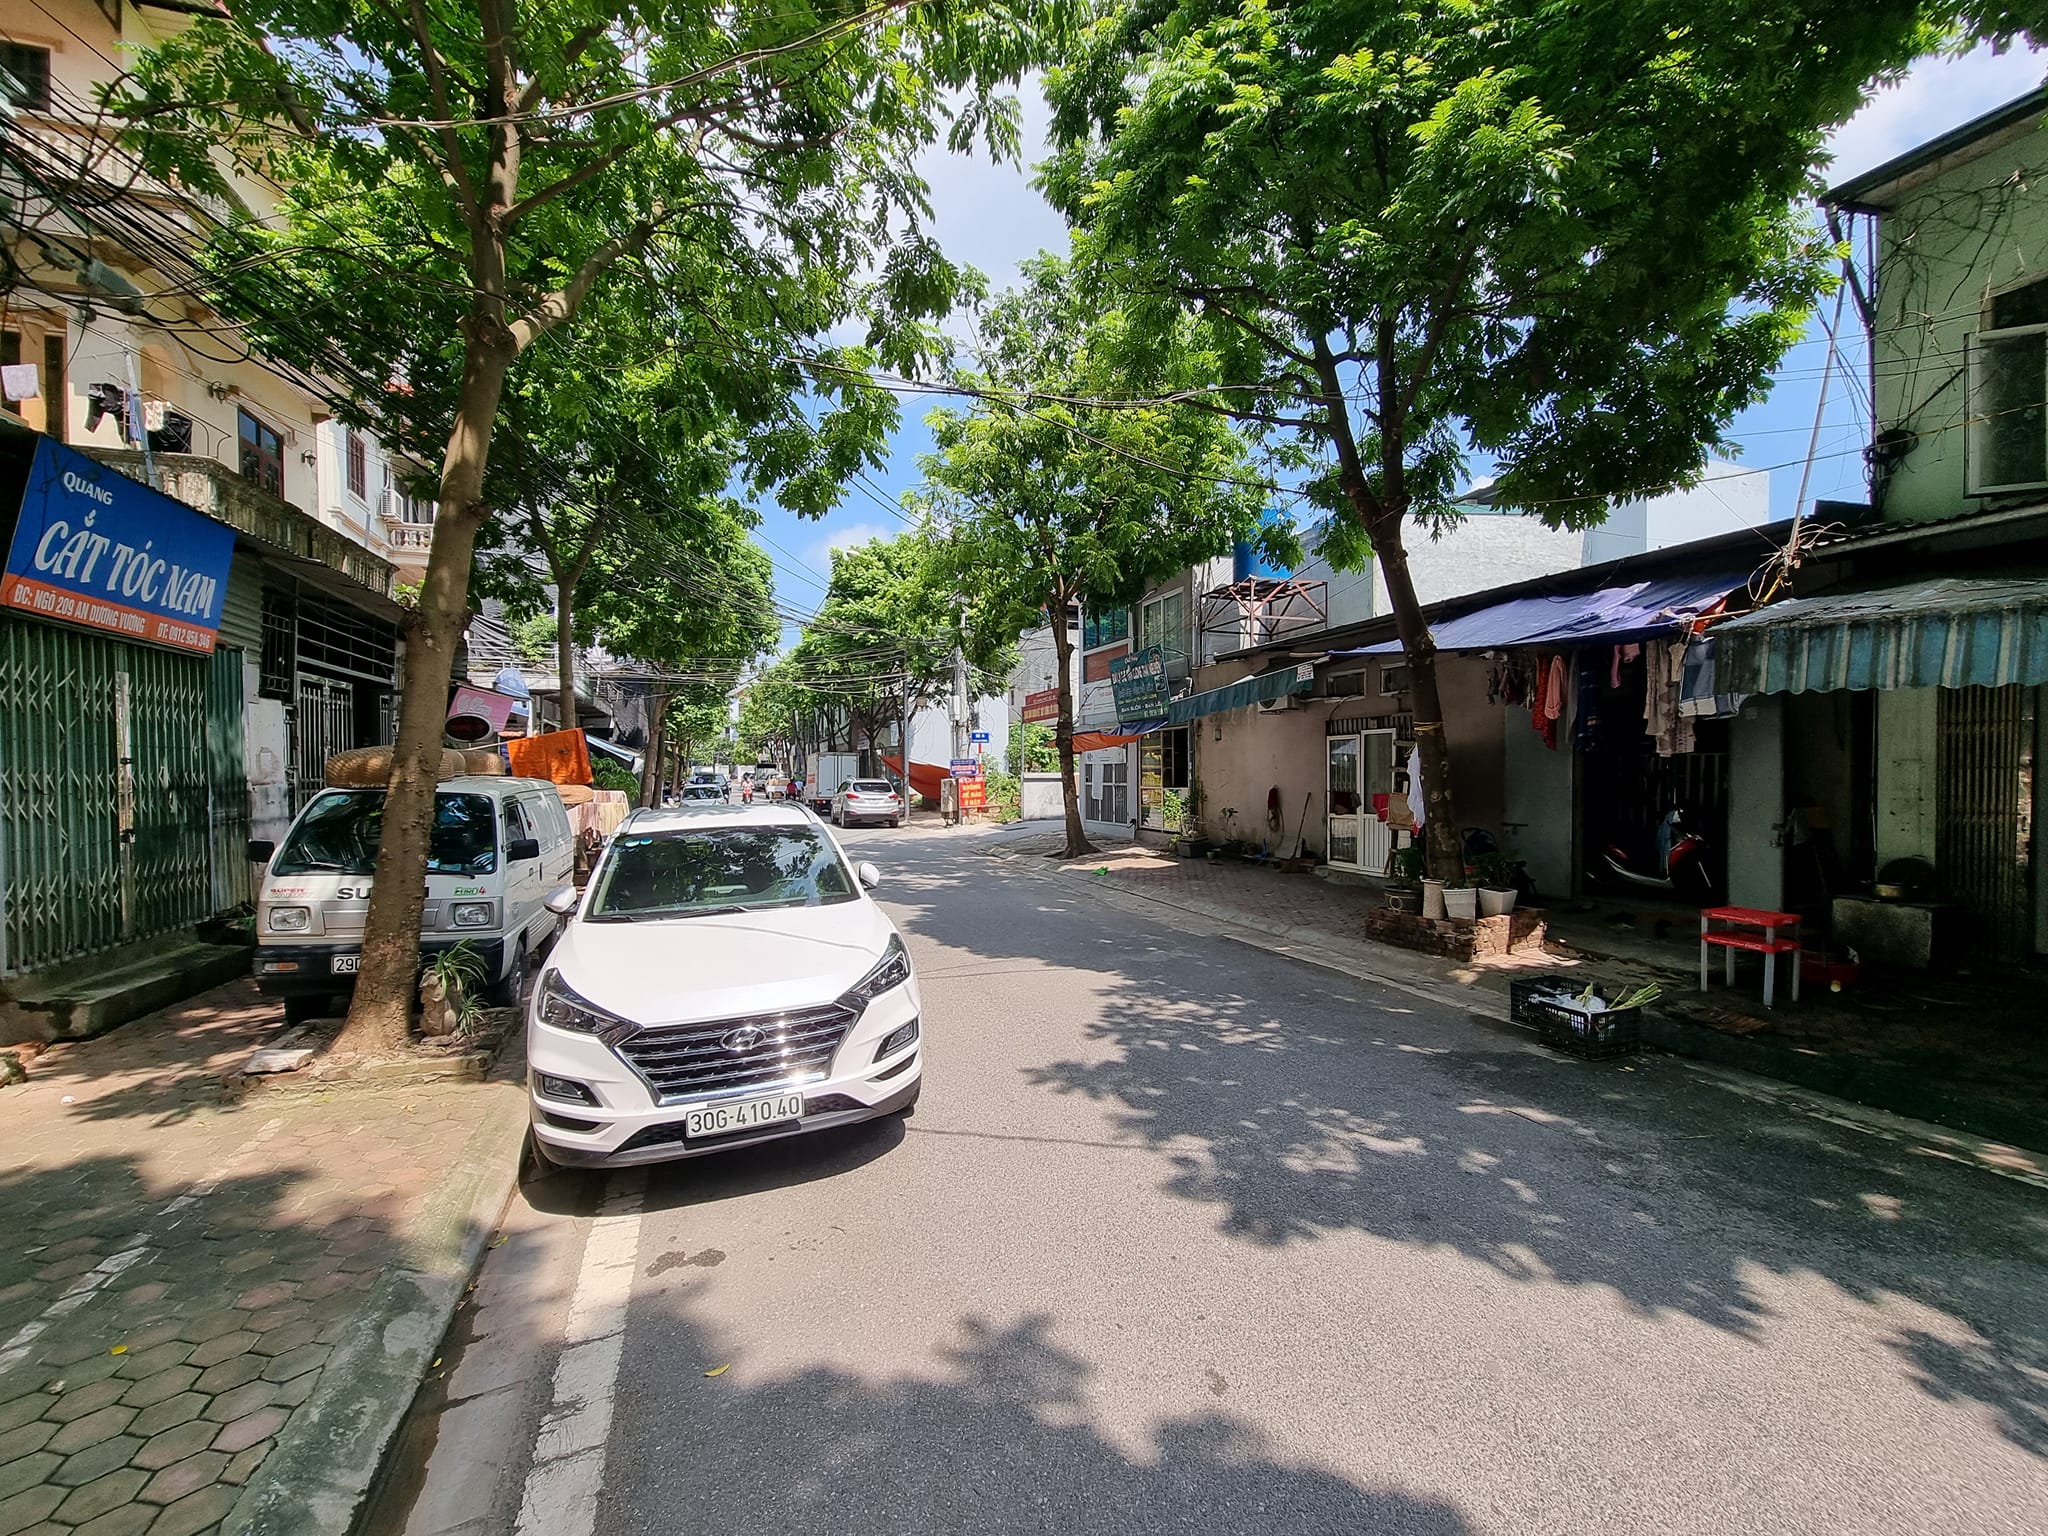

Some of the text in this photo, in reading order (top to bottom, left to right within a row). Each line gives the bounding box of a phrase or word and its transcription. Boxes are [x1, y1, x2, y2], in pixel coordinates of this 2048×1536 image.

[63, 471, 113, 506] QUANG
[34, 509, 217, 618] CẮT TÓC NAM
[33, 589, 56, 611] NGÕ
[55, 596, 75, 614] 209
[75, 601, 90, 620] AN
